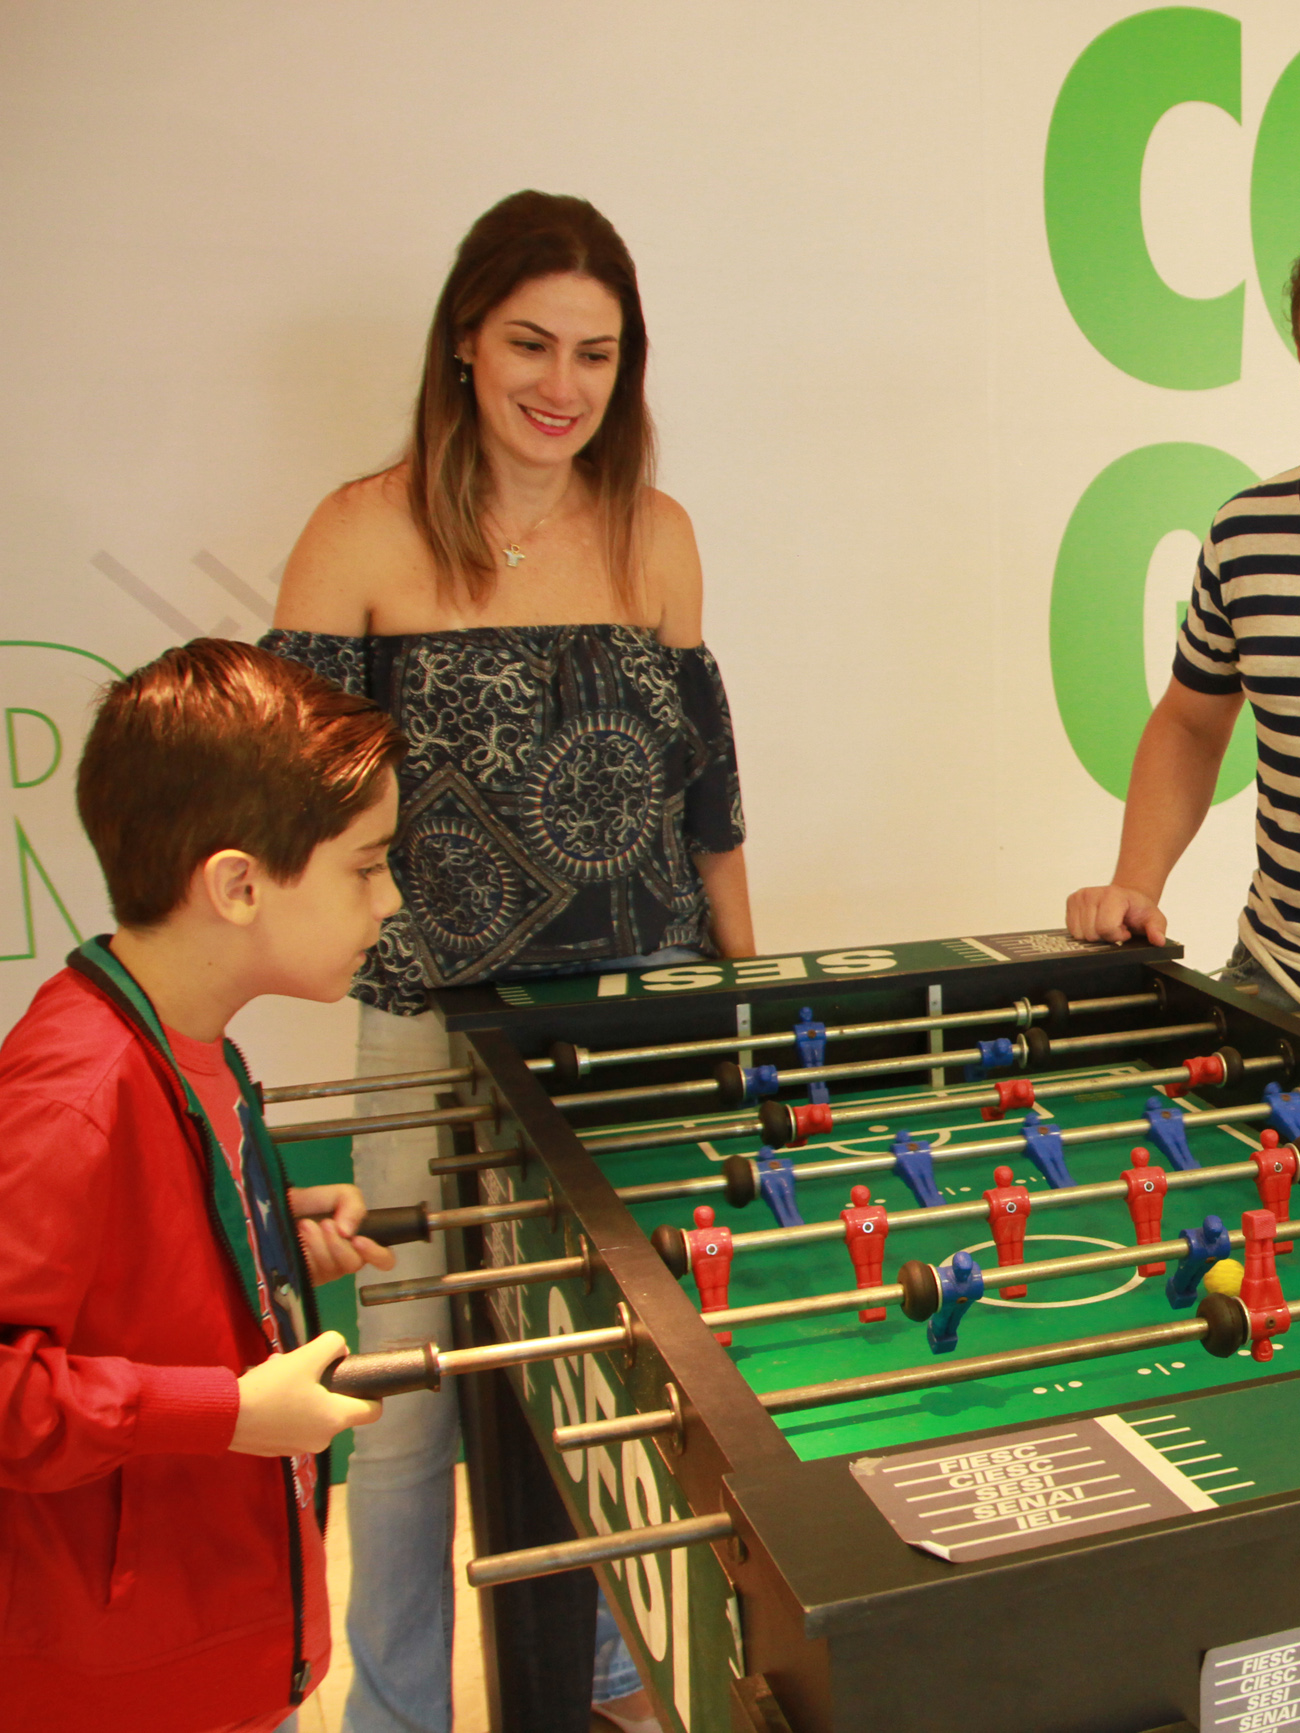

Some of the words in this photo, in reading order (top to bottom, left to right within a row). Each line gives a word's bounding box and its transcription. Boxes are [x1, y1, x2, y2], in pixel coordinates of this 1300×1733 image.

[597, 949, 897, 997] SESI
[939, 1445, 1038, 1474] FIESC
[949, 1459, 1054, 1489] CIESC
[975, 1475, 1055, 1501] SESI
[972, 1486, 1085, 1521] SENAI
[1016, 1510, 1072, 1531] IEL
[1241, 1648, 1297, 1675] FIESC
[1240, 1666, 1298, 1694] CIESC
[1246, 1687, 1290, 1711] SESI
[1239, 1703, 1299, 1732] SENAI
